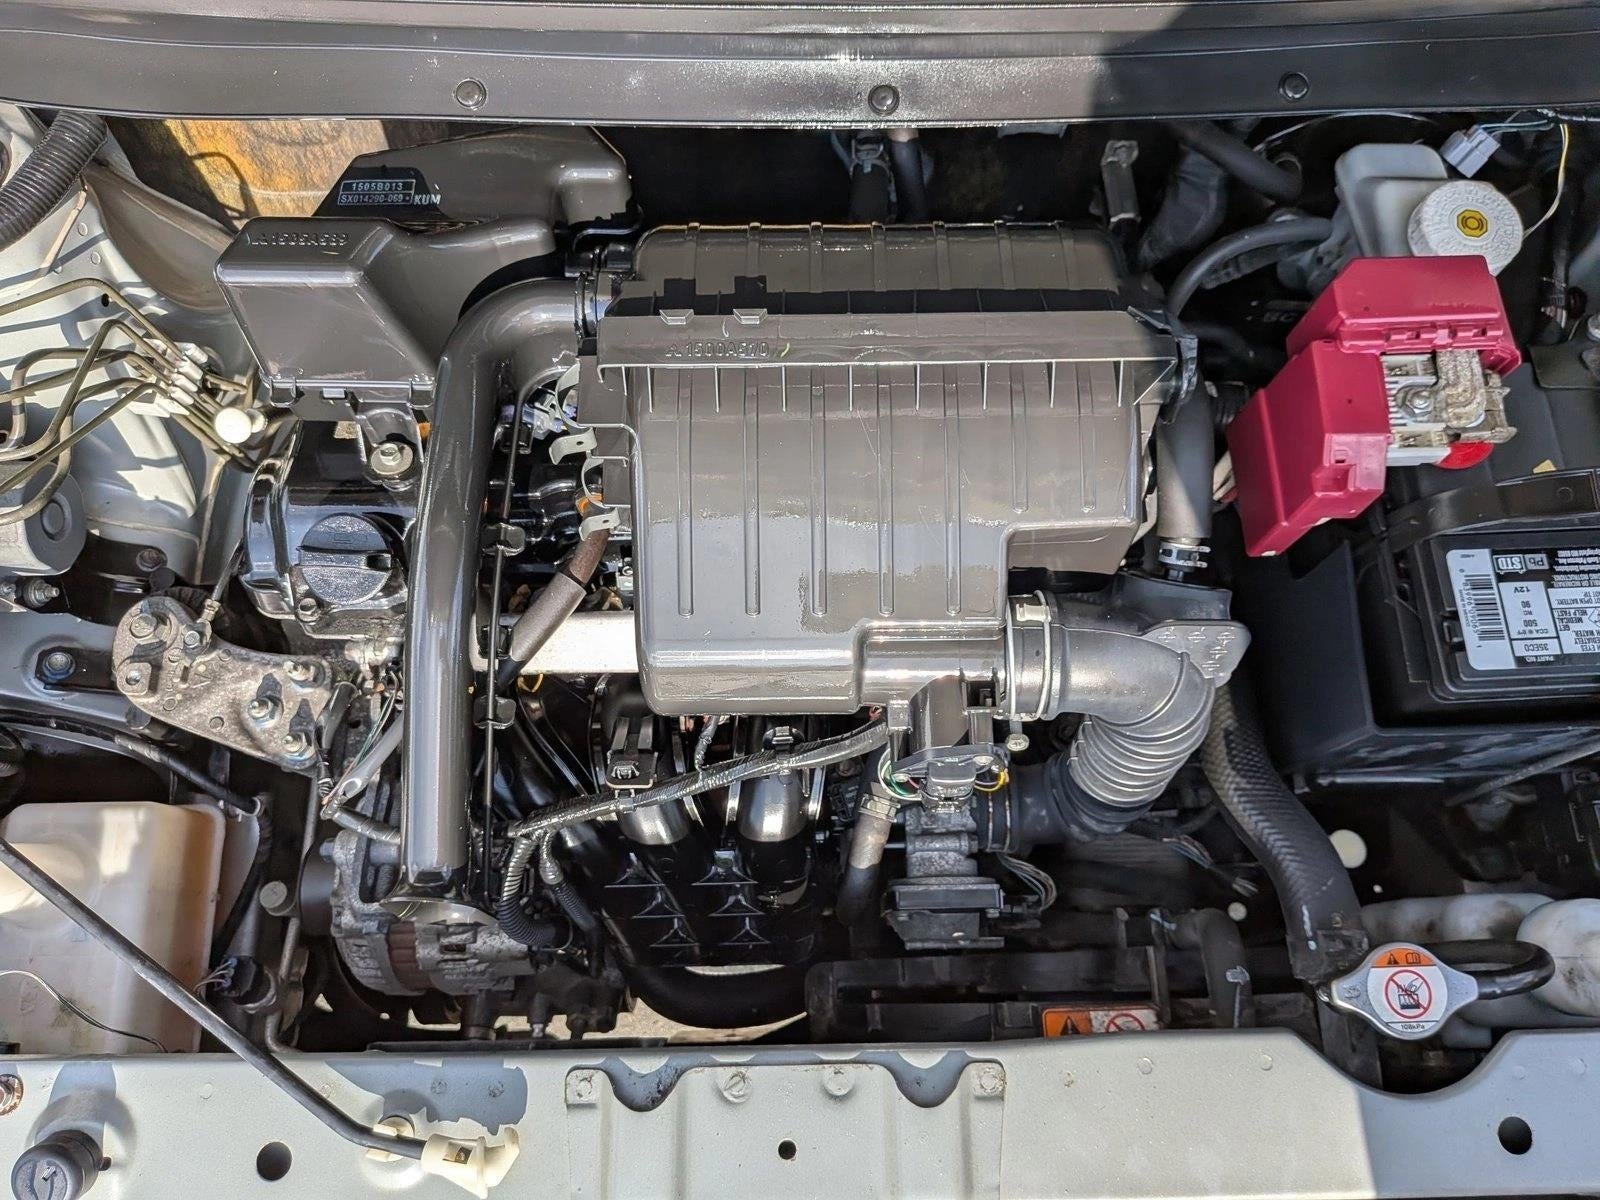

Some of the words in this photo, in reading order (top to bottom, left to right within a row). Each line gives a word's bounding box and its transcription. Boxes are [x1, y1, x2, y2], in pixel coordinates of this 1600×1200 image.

[413, 194, 441, 205] KUM
[1528, 557, 1544, 566] Pb
[1523, 619, 1538, 627] 500
[1556, 616, 1583, 624] MEDICAL
